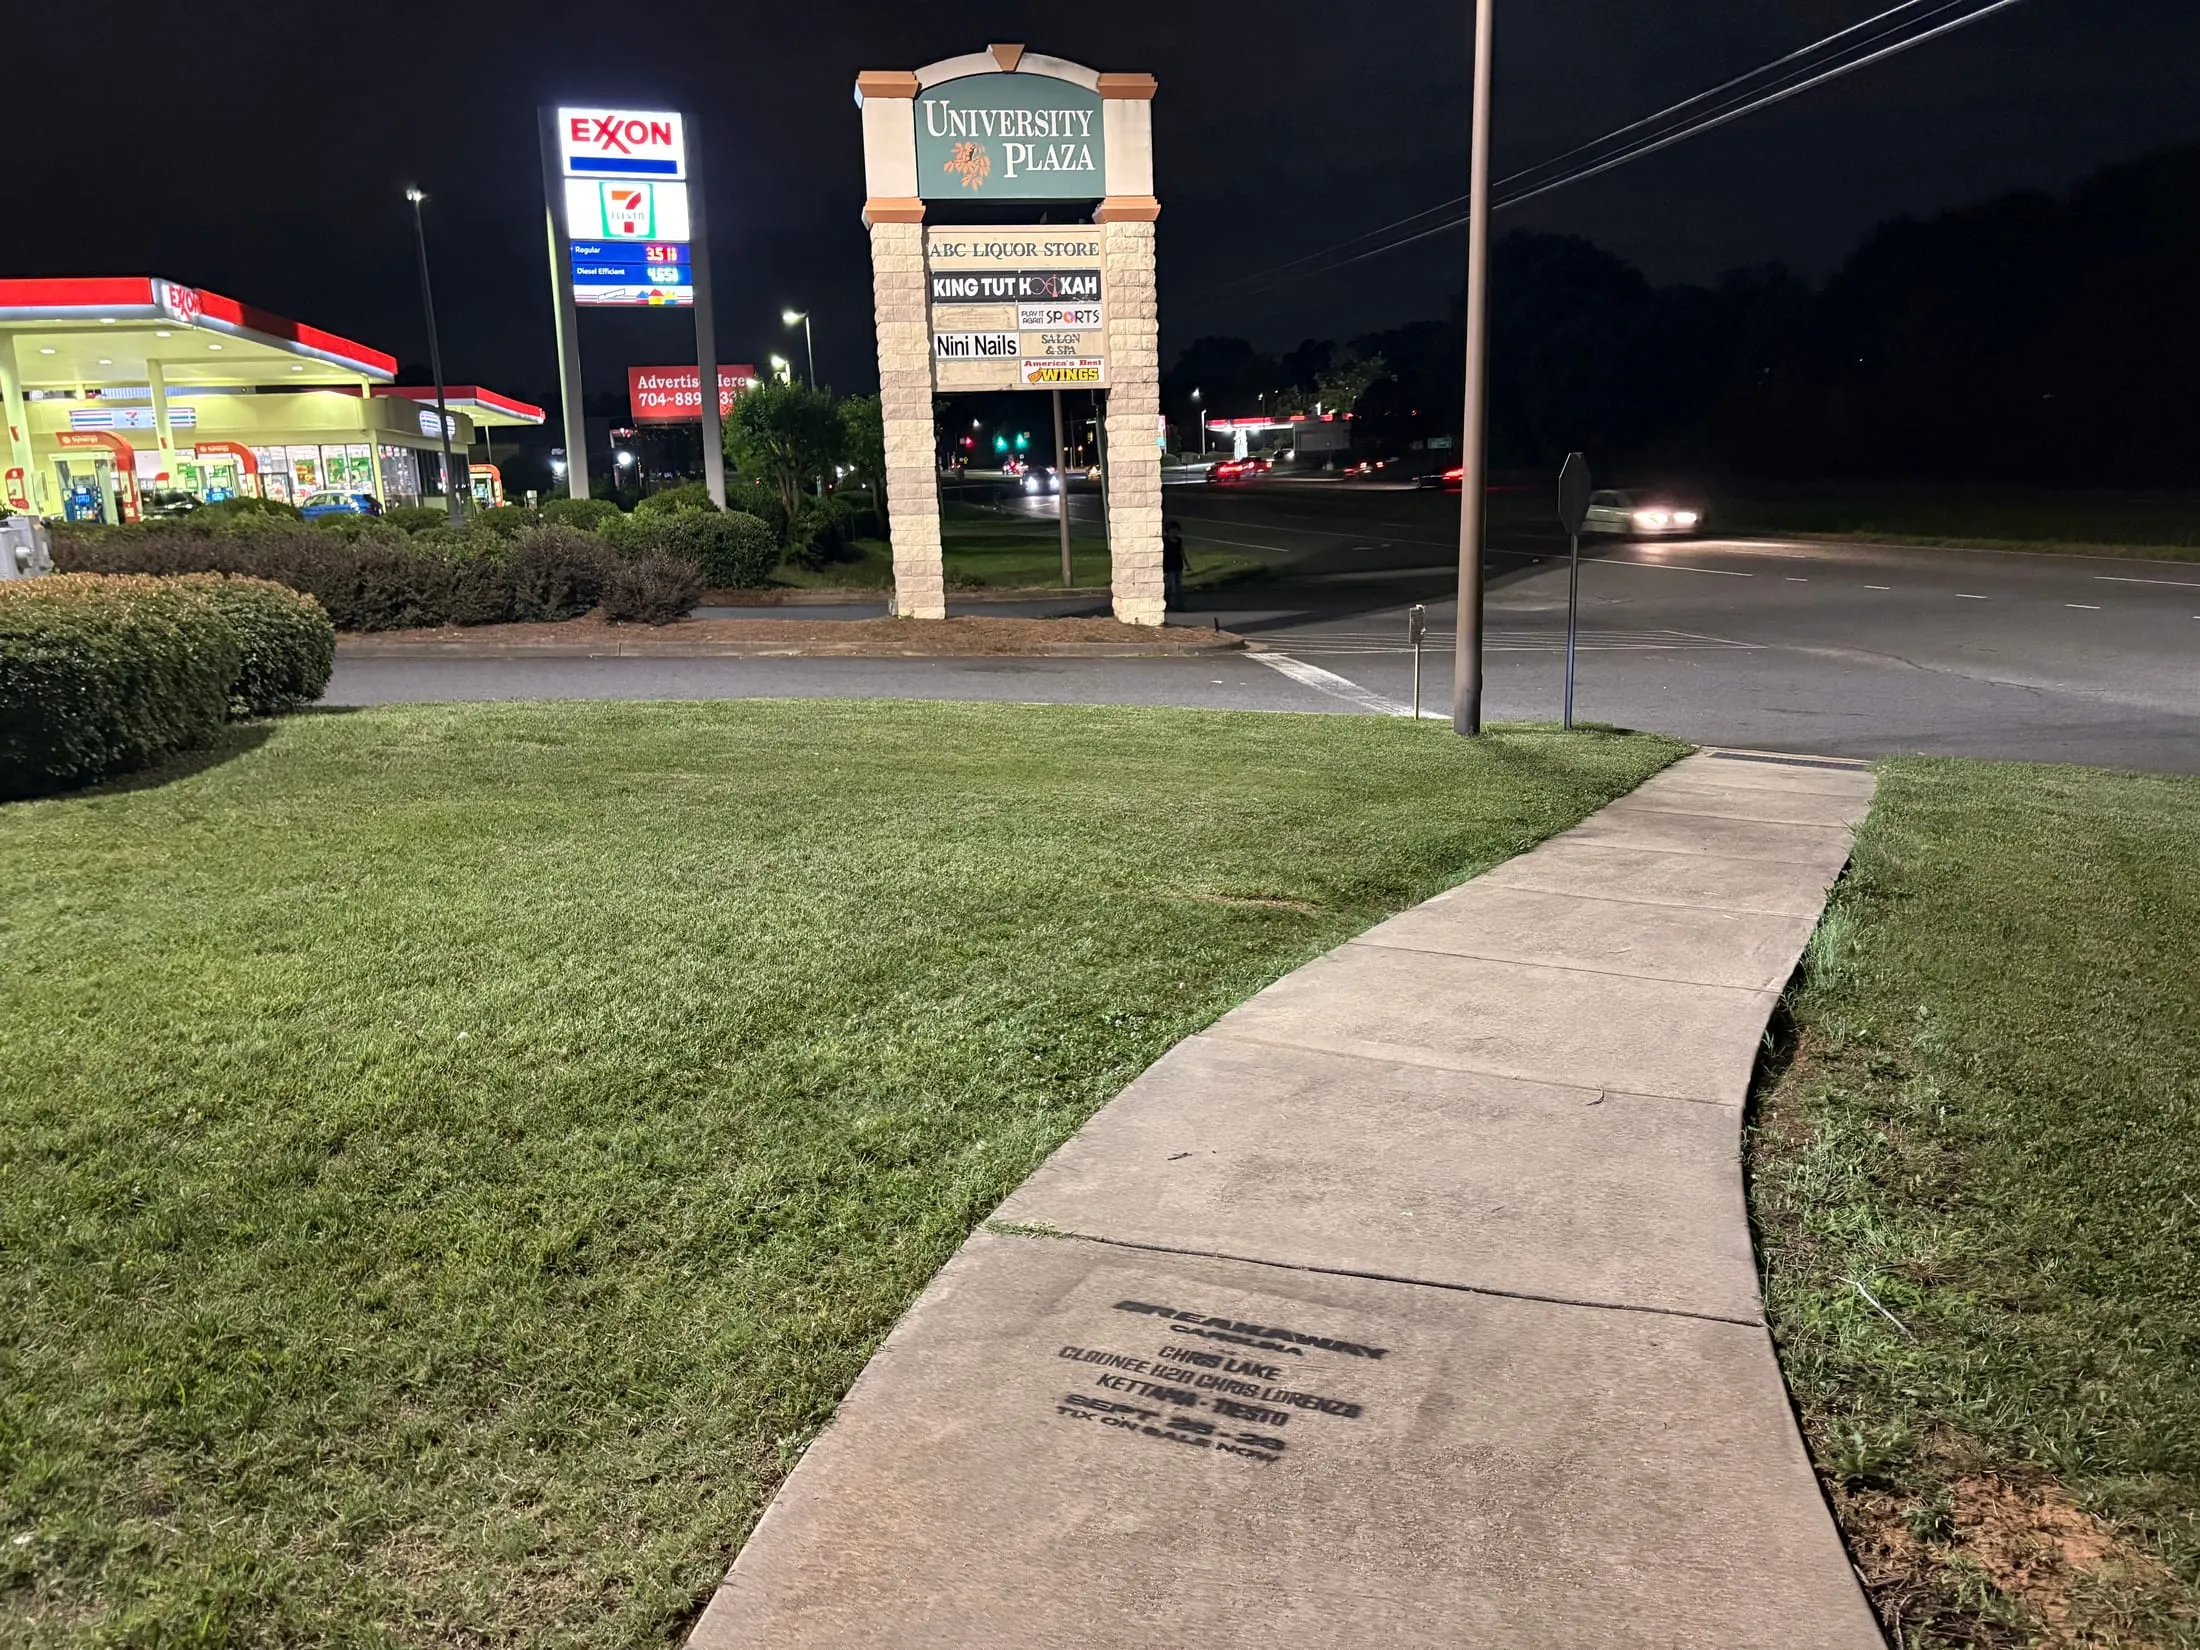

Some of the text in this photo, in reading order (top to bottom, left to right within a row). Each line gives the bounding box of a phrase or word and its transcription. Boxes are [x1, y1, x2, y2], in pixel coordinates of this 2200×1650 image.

[923, 100, 1094, 137] UNIVERSITY
[571, 115, 672, 154] EXXON
[1002, 142, 1096, 178] PLAZA
[611, 191, 642, 233] 7
[575, 246, 601, 255] Regular
[930, 242, 1099, 259] ABC LIQUOR STORE
[576, 267, 625, 275] Diesel Efficient
[933, 278, 979, 297] KING
[981, 277, 1016, 297] TUT
[1046, 310, 1100, 324] SPORTS
[937, 334, 1017, 357] Nini Nails
[1041, 333, 1081, 344] SALON
[1045, 345, 1077, 355] & SPA
[1024, 359, 1102, 367] America's Best
[637, 374, 700, 389] Advertis
[1041, 367, 1099, 382] WINGS
[1158, 1345, 1281, 1381] CHRIS LAKE
[1195, 1374, 1260, 1397] CHRIS
[1064, 1394, 1160, 1421] SEPT
[1056, 1405, 1097, 1421] TIX
[1100, 1416, 1139, 1431] ON
